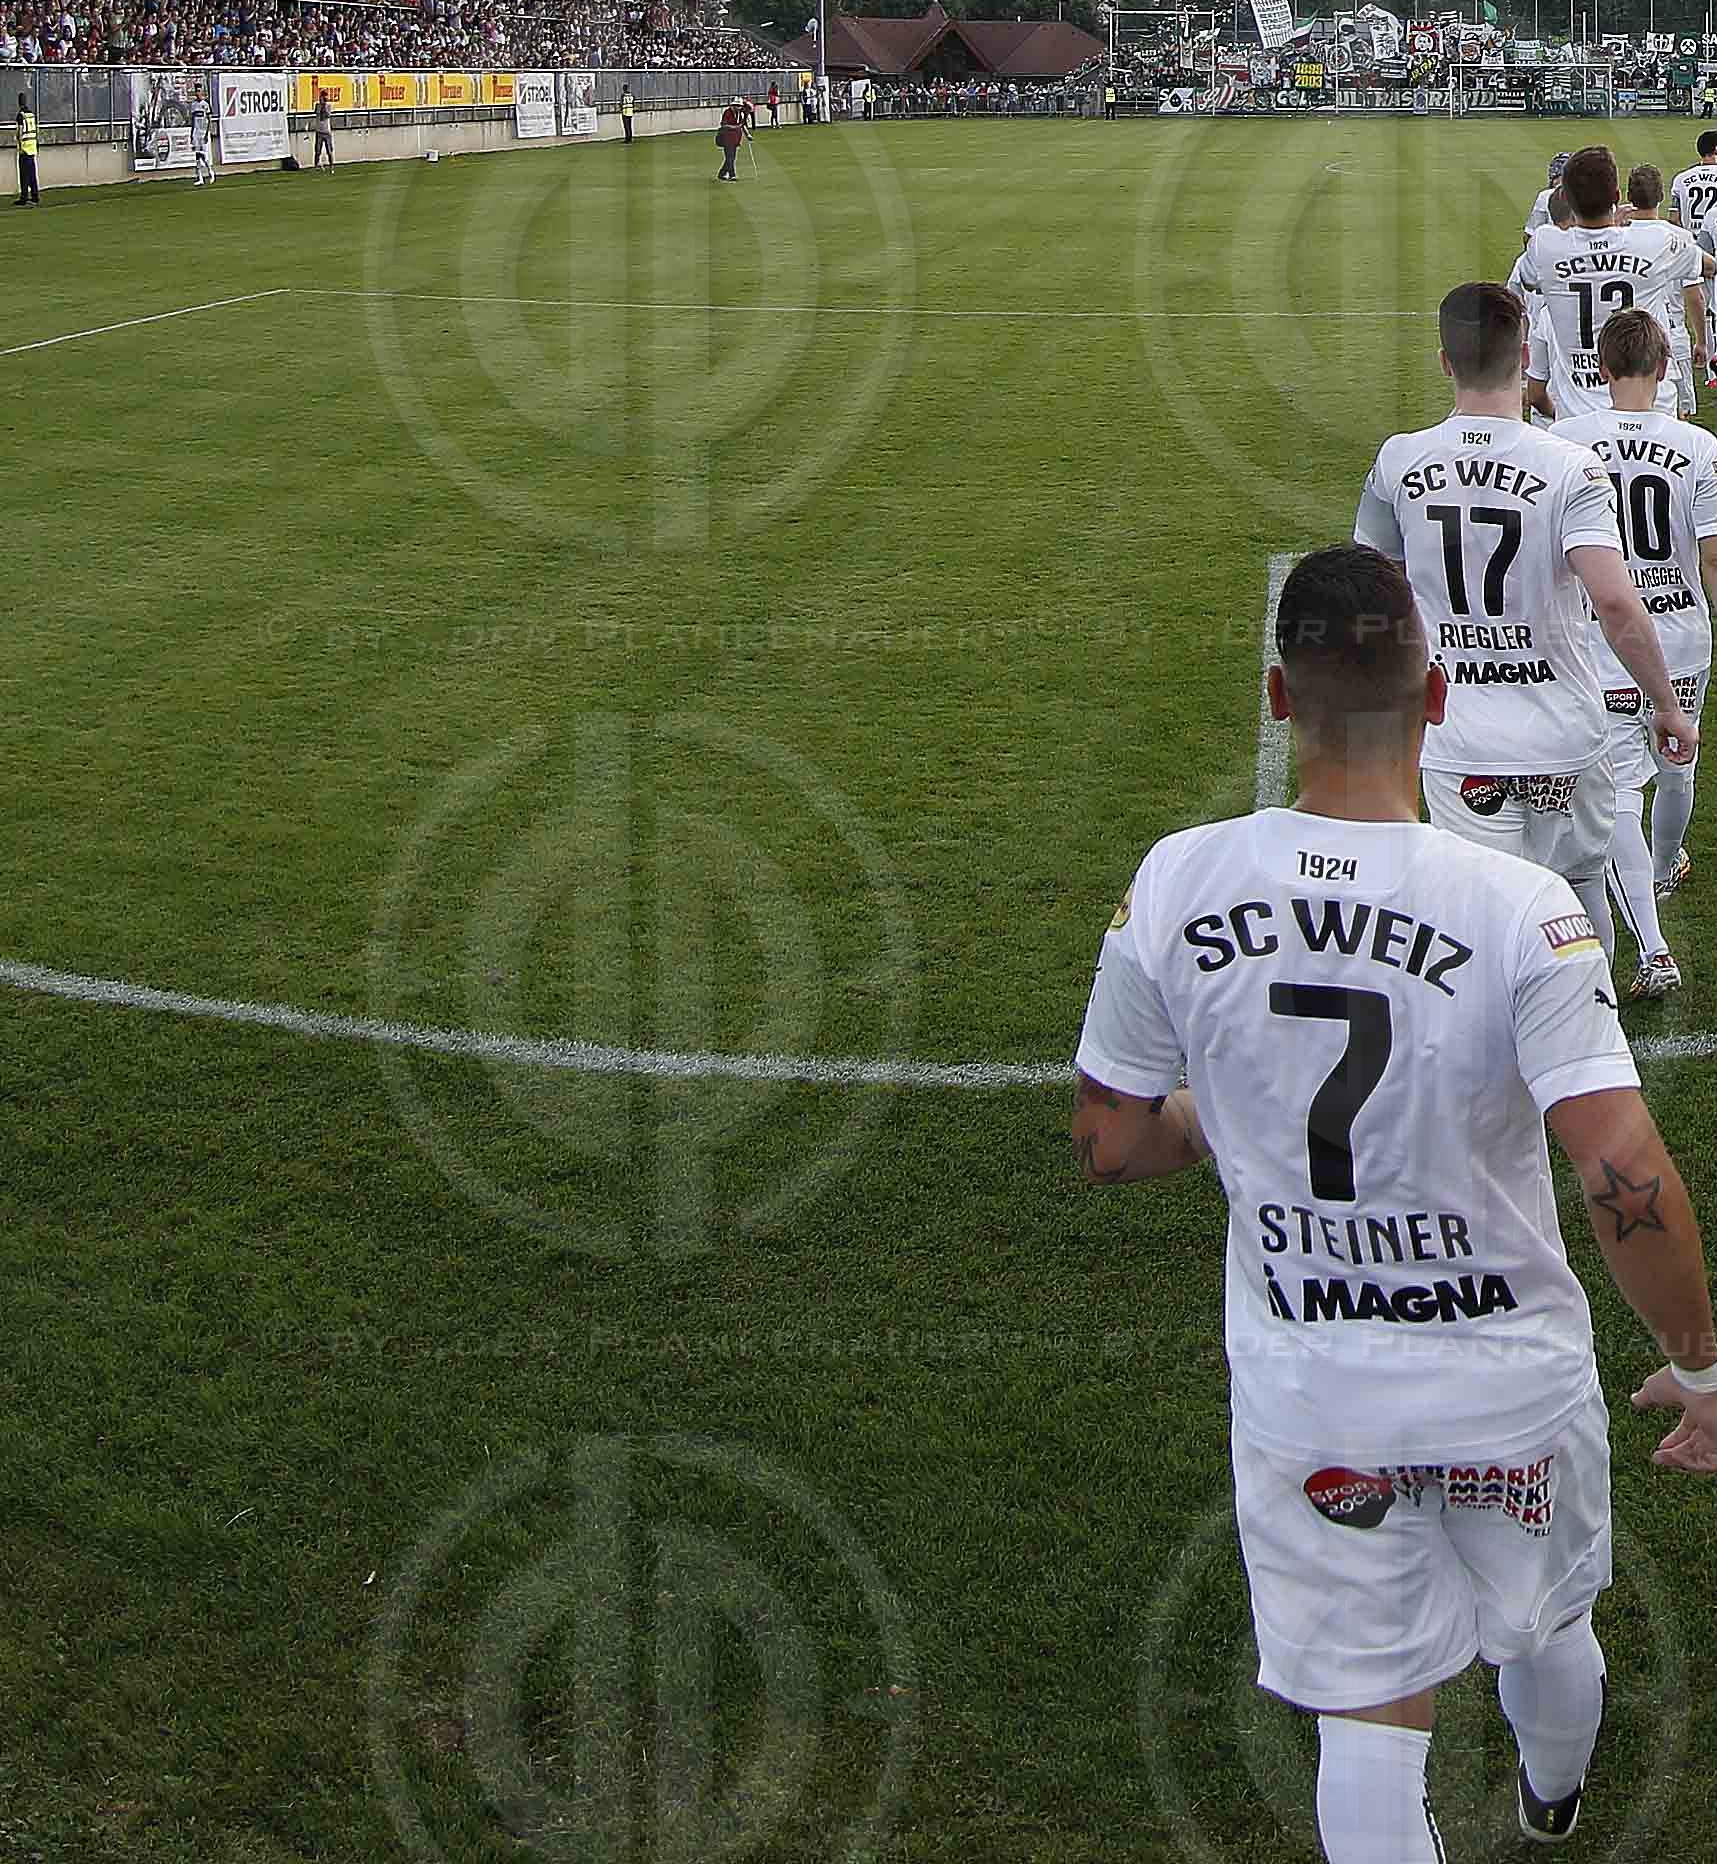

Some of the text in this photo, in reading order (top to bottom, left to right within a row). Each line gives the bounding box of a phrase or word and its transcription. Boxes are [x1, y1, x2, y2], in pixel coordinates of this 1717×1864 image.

[239, 88, 285, 115] STROBL
[1554, 255, 1653, 279] SC WEIZ
[1572, 353, 1601, 370] REIS
[1461, 431, 1492, 446] 1924
[1617, 421, 1643, 432] 1924
[1598, 439, 1693, 479] C WEIZ
[1400, 460, 1548, 506] SC WEIZ
[1425, 504, 1523, 617] 17
[1439, 622, 1533, 651] RIEGLER
[1454, 659, 1558, 686] MAGNA
[1605, 692, 1640, 702] SPORT
[1296, 851, 1359, 882] 1924
[1182, 899, 1475, 998] SC WEIZ
[1267, 982, 1394, 1203] 7
[1257, 1203, 1475, 1266] STEINER
[1302, 1274, 1519, 1324] MAGNA
